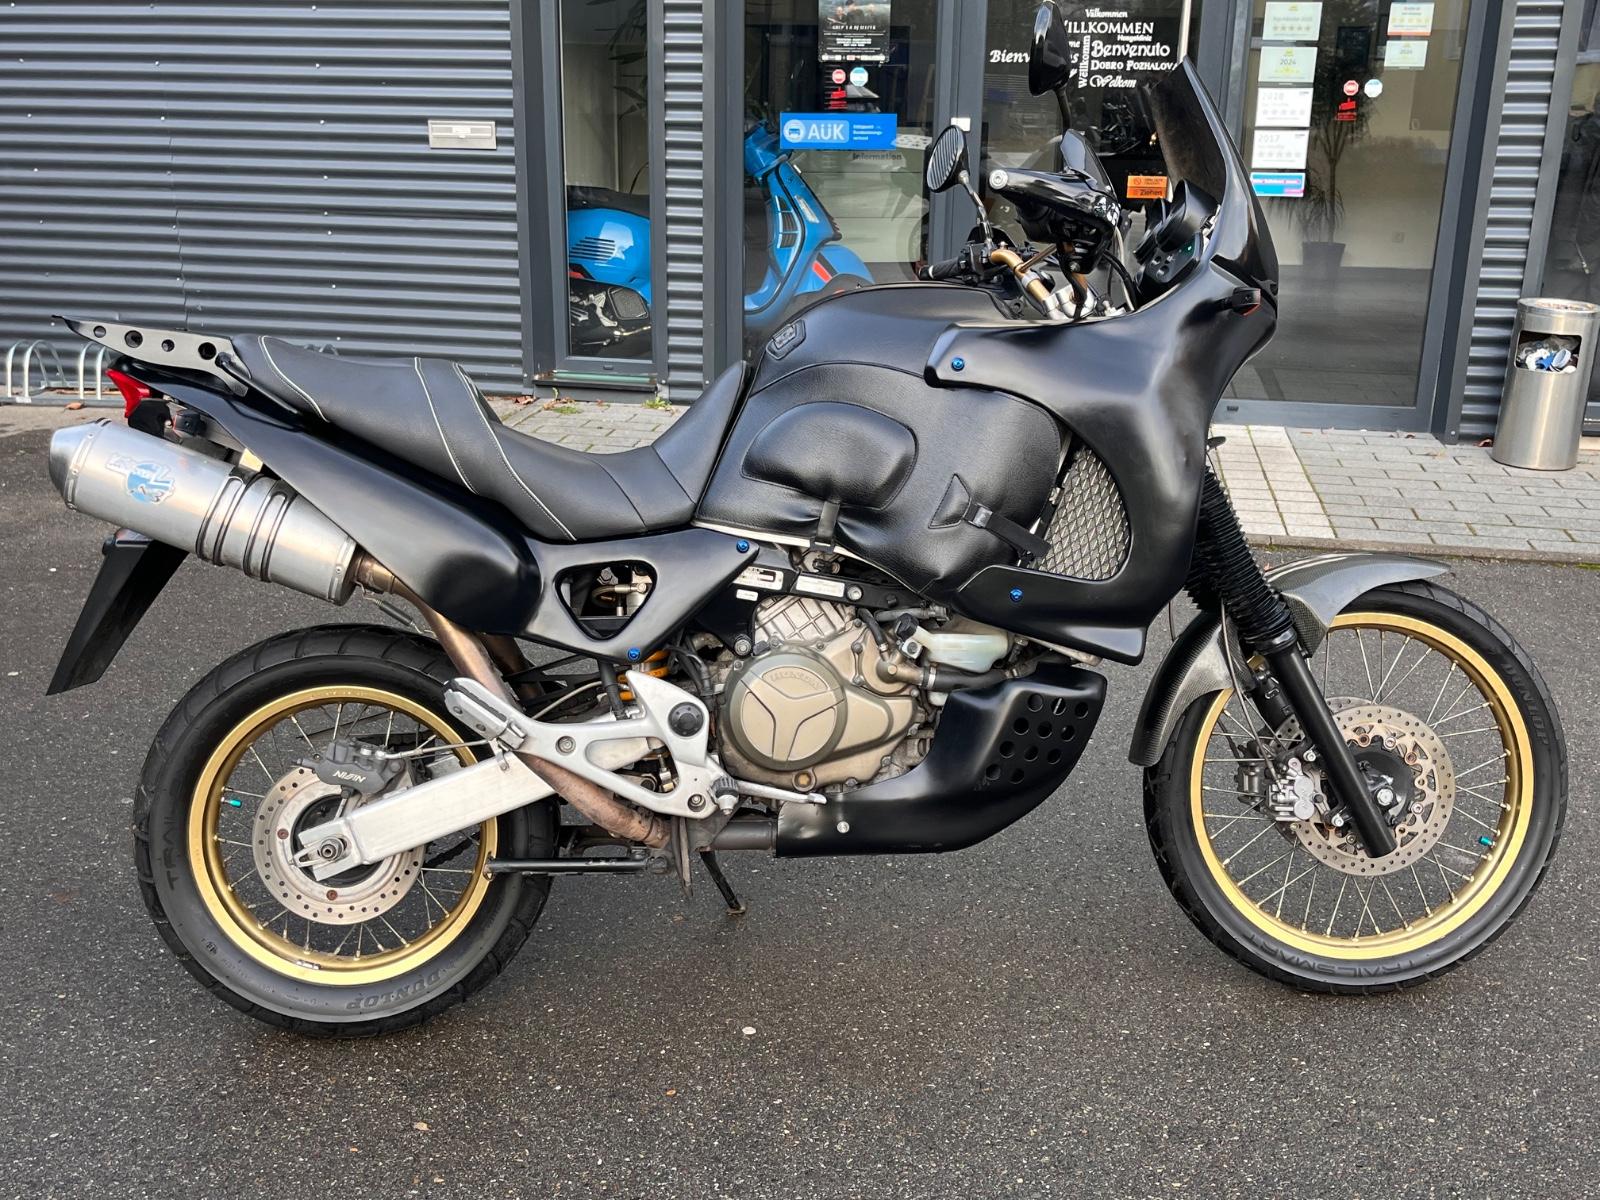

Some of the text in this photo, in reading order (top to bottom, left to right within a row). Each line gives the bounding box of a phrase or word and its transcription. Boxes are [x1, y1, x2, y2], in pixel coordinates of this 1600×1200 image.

[1091, 40, 1171, 57] Benvenuto
[1089, 74, 1137, 88] Welkom
[345, 968, 440, 1011] DUNLOP
